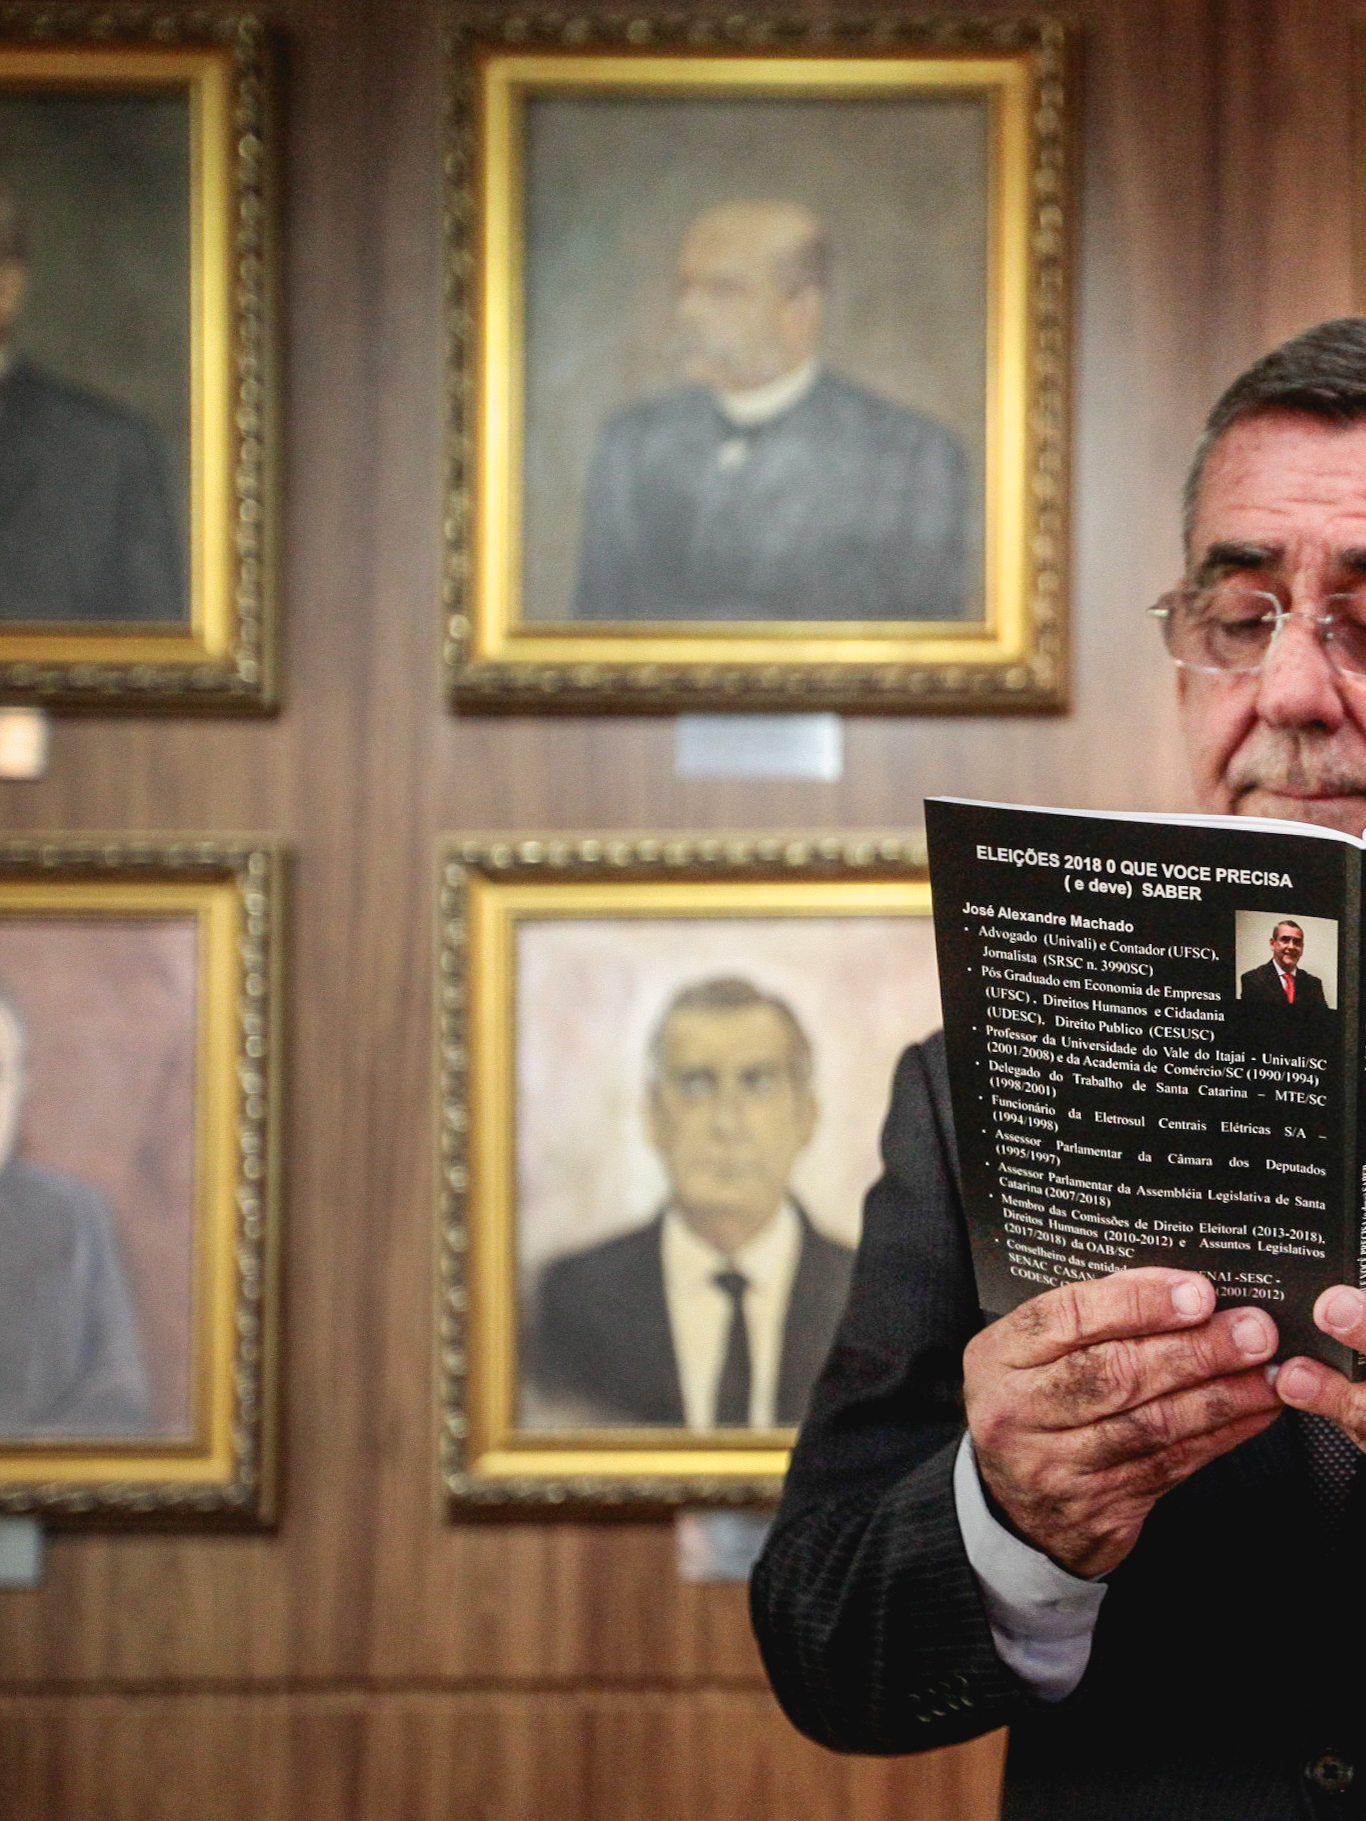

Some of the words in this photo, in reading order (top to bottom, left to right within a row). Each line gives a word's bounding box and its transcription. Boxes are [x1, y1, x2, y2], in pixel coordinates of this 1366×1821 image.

[976, 845, 1060, 868] ELEIÇÕES
[1064, 855, 1101, 872] 2018
[1120, 860, 1158, 877] QUE
[1161, 863, 1211, 881] VOCE
[1215, 867, 1293, 888] PRECISA
[1074, 879, 1084, 890] e
[1089, 878, 1133, 899] deve)
[1142, 882, 1202, 900] SABER
[962, 902, 995, 917] José
[998, 906, 1067, 926] Alexandre
[1070, 914, 1134, 933] Machado
[978, 925, 1037, 944] Advogado
[1043, 933, 1097, 951] (Univali)
[1099, 940, 1107, 950] e
[1109, 940, 1166, 956] Contador
[1168, 945, 1220, 962] (UFSC).
[982, 945, 1037, 964] Jornalista
[1043, 954, 1084, 969] (SRSC
[1086, 962, 1098, 971] n.
[1101, 960, 1154, 977] 3990SC)
[981, 965, 1001, 978] Pós
[1004, 968, 1060, 986] Graduado
[1062, 979, 1081, 989] em
[1084, 979, 1143, 996] Economia
[1145, 984, 1161, 997] de
[1164, 986, 1221, 1001] Empresas
[987, 1005, 1046, 1025] (UDESC).
[1055, 1015, 1095, 1031] Direito
[1098, 1020, 1143, 1036] Publico
[1149, 1026, 1215, 1042] (CESUSC)
[1043, 994, 1089, 1011] Direitos
[1092, 1000, 1148, 1016] Humanos
[1164, 1006, 1225, 1021] Cidadania
[986, 1024, 1038, 1043] Professor
[1042, 1033, 1056, 1046] da
[1061, 1036, 1137, 1055] Universidade
[1142, 1045, 1158, 1057] do
[1163, 1046, 1189, 1059] Vale
[1194, 1048, 1210, 1061] do
[1215, 1050, 1245, 1065] Itajaí
[1262, 1052, 1328, 1071] Univali/SC
[987, 1041, 1054, 1063] (2001/2008)
[1056, 1053, 1064, 1063] e
[1066, 1053, 1080, 1066] da
[1083, 1055, 1140, 1072] Academia
[1143, 1062, 1158, 1073] de
[1164, 1062, 1244, 1079] Comércio/SC
[1247, 1068, 1319, 1088] (1990/1994)
[988, 1059, 1041, 1079] Delegado
[1049, 1070, 1064, 1082] do
[1072, 1073, 1123, 1090] Trabalho
[1132, 1080, 1147, 1092] de
[1156, 1082, 1189, 1095] Santa
[1198, 1084, 1248, 1098] Catarina
[1274, 1089, 1328, 1107] MTE/SC
[989, 1076, 1057, 1098] (1998/2001)
[991, 1094, 1056, 1116] Funcionário
[1068, 1108, 1082, 1120] da
[1094, 1111, 1145, 1127] Eletrosul
[1158, 1117, 1207, 1131] Centrais
[1220, 1121, 1271, 1135] Elétricas
[1284, 1126, 1307, 1139] S/A
[993, 1110, 1059, 1133] (1994/1998)
[995, 1129, 1042, 1147] Assessor
[1056, 1140, 1123, 1160] Parlamentar
[1138, 1151, 1152, 1163] da
[1167, 1152, 1213, 1167] Câmara
[1229, 1157, 1250, 1168] dos
[1265, 1159, 1327, 1177] Deputados
[996, 1144, 1061, 1167] (1995/1997)
[998, 1162, 1044, 1181] Assessor
[1048, 1172, 1113, 1192] Parlamentar
[1117, 1183, 1131, 1195] da
[1136, 1185, 1202, 1200] Assembléia
[1208, 1189, 1271, 1204] Legislativa
[1275, 1193, 1290, 1205] de
[1294, 1196, 1326, 1210] Santa
[999, 1176, 1043, 1195] Catarina
[1044, 1187, 1111, 1209] (2007/2018)
[1001, 1193, 1045, 1213] Membro
[1048, 1204, 1067, 1218] das
[1071, 1209, 1130, 1228] Comissões
[1134, 1218, 1149, 1230] de
[1153, 1220, 1194, 1233] Direito
[1199, 1222, 1248, 1235] Eleitoral
[1002, 1207, 1044, 1227] Direitos
[1048, 1218, 1099, 1238] Humanos
[1104, 1230, 1174, 1248] (2010-2012)
[1178, 1239, 1187, 1248] e
[1199, 1238, 1251, 1251] Assuntos
[1257, 1240, 1326, 1259] Legislativos
[1004, 1222, 1067, 1248] (2017/2018)
[1071, 1237, 1084, 1250] da
[1086, 1242, 1136, 1259] OAB/SC
[1006, 1238, 1066, 1262] Conselheiro
[1068, 1254, 1086, 1267] das
[1088, 1261, 1127, 1273] entidad
[1008, 1252, 1048, 1271] SENAC
[1010, 1266, 1059, 1288] CODESC
